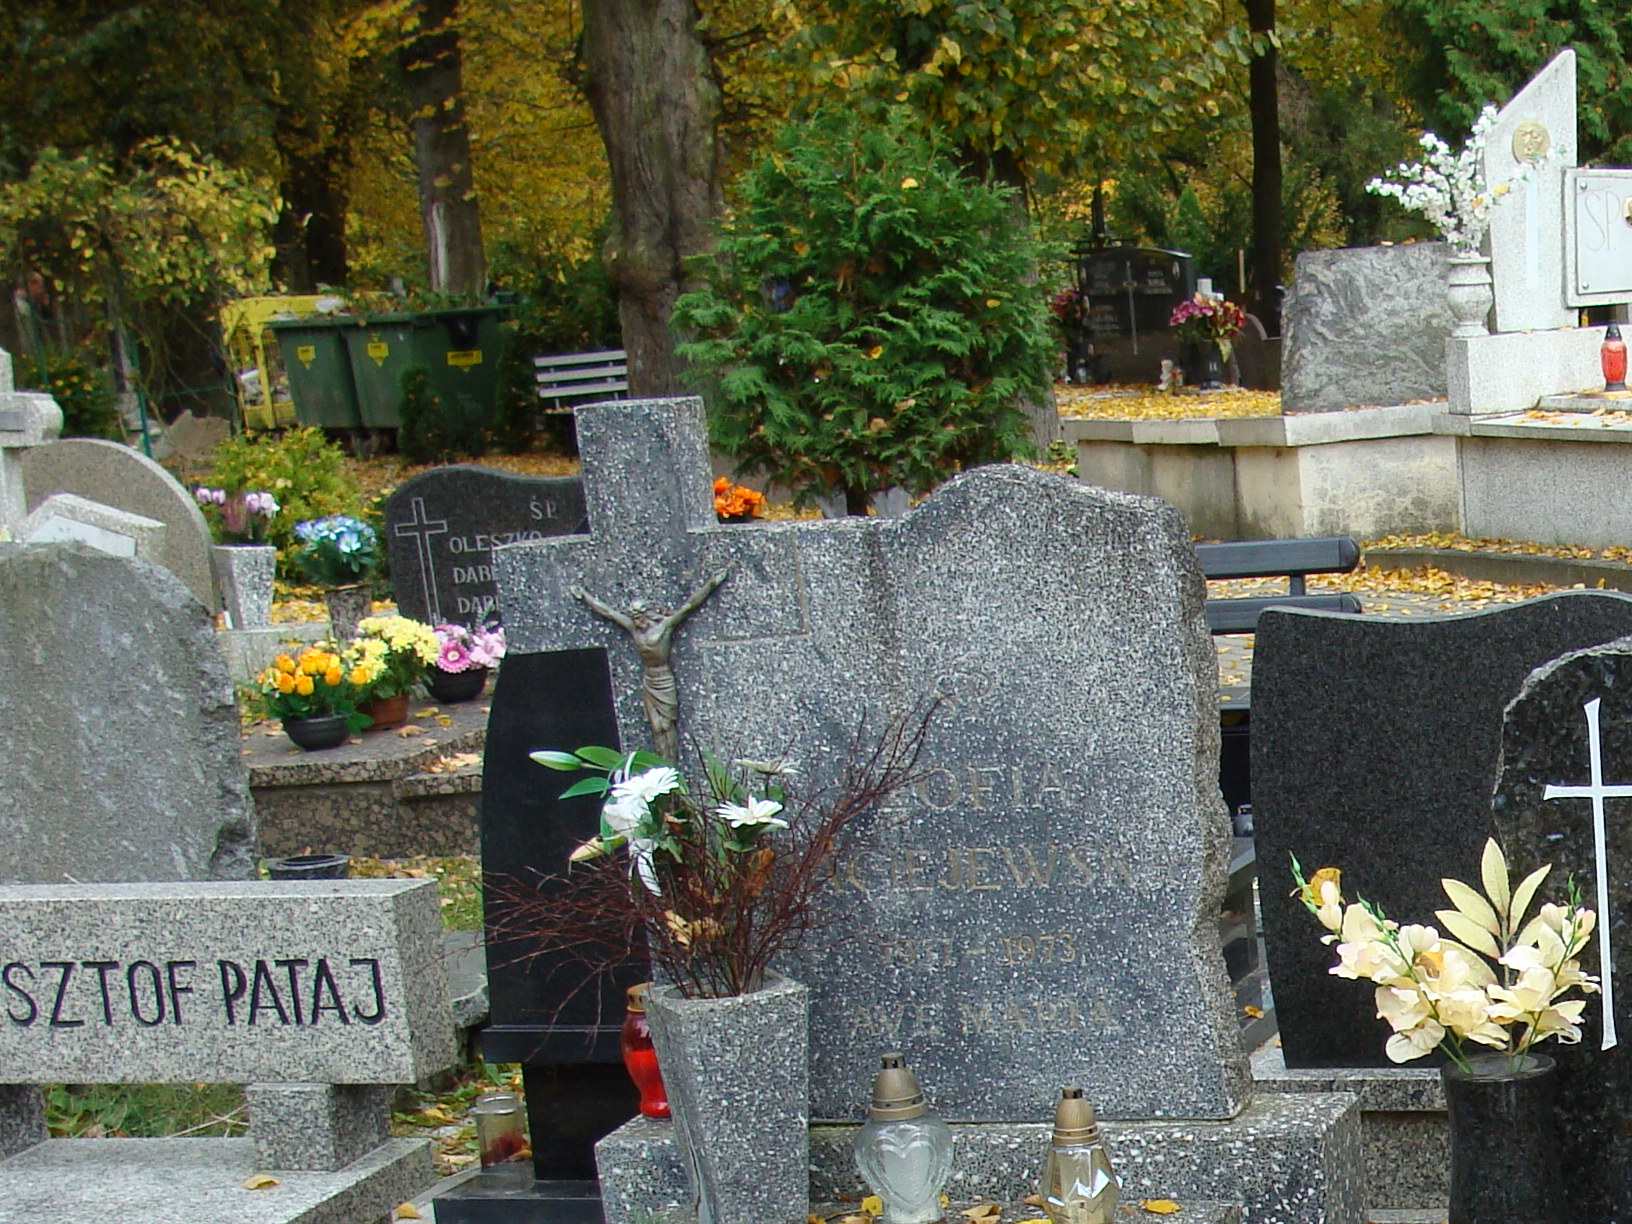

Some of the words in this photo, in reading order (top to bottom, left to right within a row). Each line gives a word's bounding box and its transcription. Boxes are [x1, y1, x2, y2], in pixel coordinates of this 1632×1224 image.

[1002, 932, 1077, 966] 1973
[2, 960, 197, 1027] SZTOF
[217, 957, 387, 1027] PATAJ
